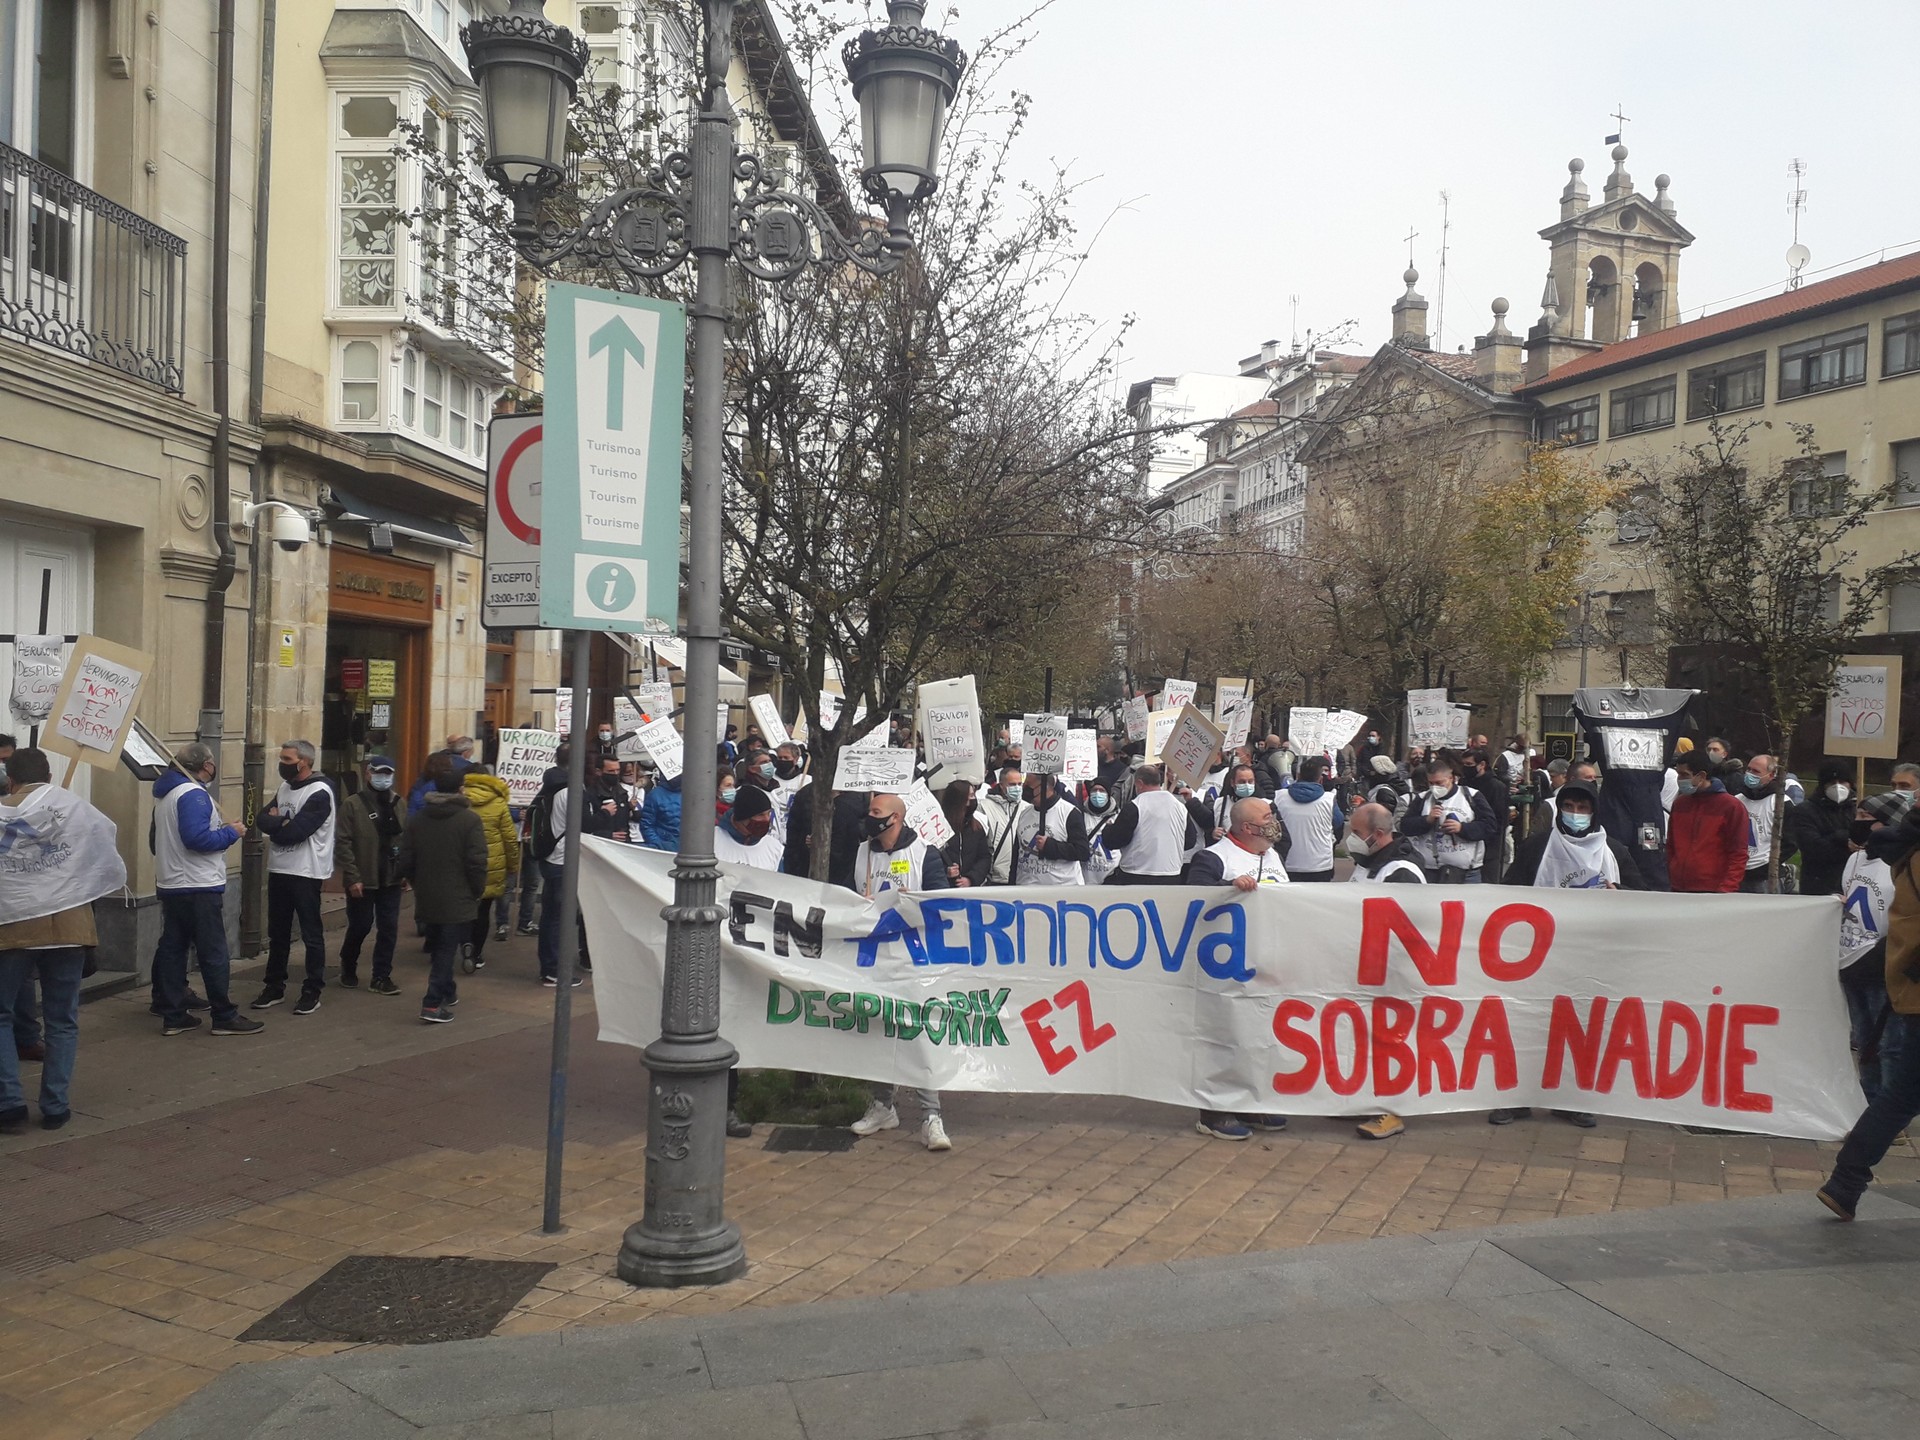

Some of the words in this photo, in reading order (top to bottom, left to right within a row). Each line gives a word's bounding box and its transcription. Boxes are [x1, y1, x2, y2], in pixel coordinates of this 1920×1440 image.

[587, 439, 641, 456] Turismoa
[589, 465, 637, 480] Turismo
[589, 490, 637, 504] Tourism
[585, 514, 640, 530] Tourisme
[491, 572, 533, 583] EXCEPTO
[19, 660, 60, 677] DESPIDE
[81, 699, 109, 719] EZ
[62, 713, 119, 742] SOBERAN
[1840, 711, 1883, 735] NO
[1033, 737, 1059, 752] NO
[1025, 750, 1061, 763] SOBRA
[1026, 761, 1055, 773] NADIE
[844, 780, 889, 788] DESPIDORIK
[728, 890, 826, 959] EN
[1357, 896, 1556, 986] NO
[766, 978, 1011, 1048] DESPIDORIK
[1020, 979, 1117, 1077] EZ
[1272, 994, 1519, 1098] SOBRA
